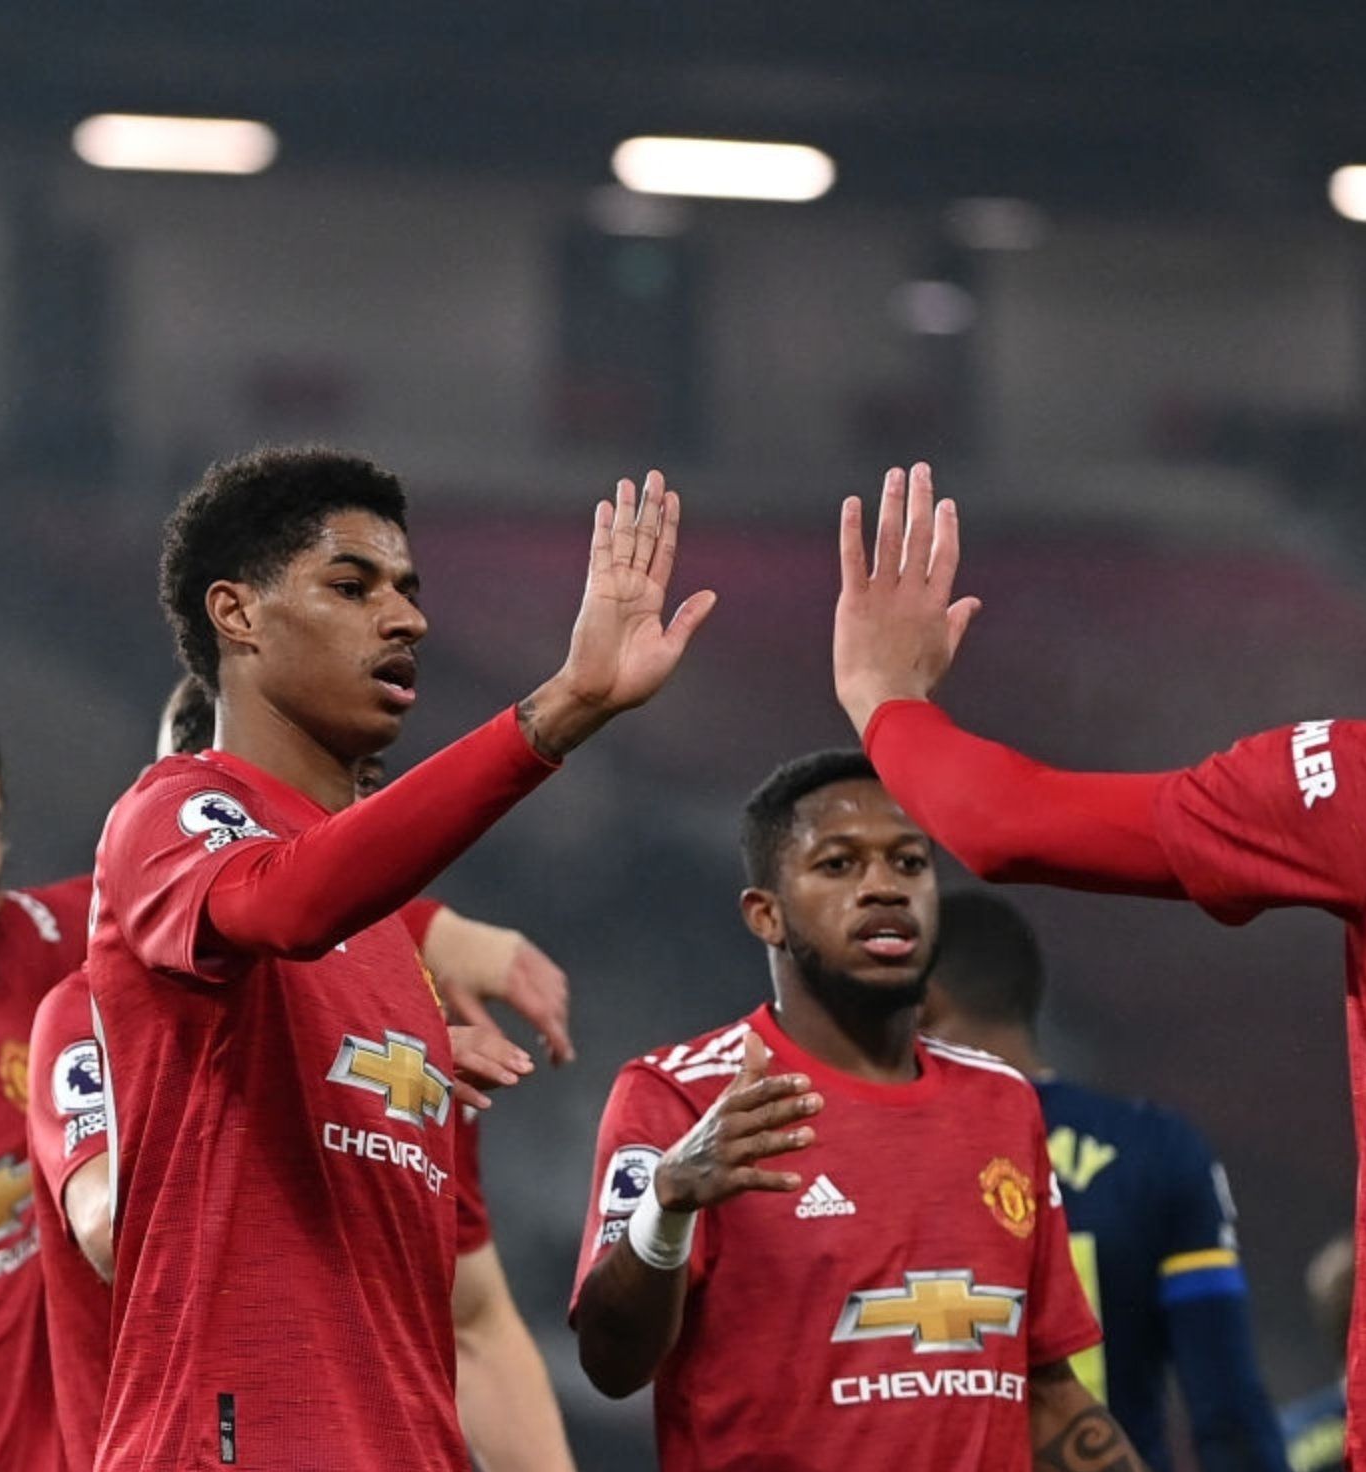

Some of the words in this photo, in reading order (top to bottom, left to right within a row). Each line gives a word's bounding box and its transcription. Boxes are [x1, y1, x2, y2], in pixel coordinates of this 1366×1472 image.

[323, 1122, 448, 1197] CHEVRET
[795, 1201, 856, 1219] adidas
[831, 1368, 1026, 1405] CHEVROLET
